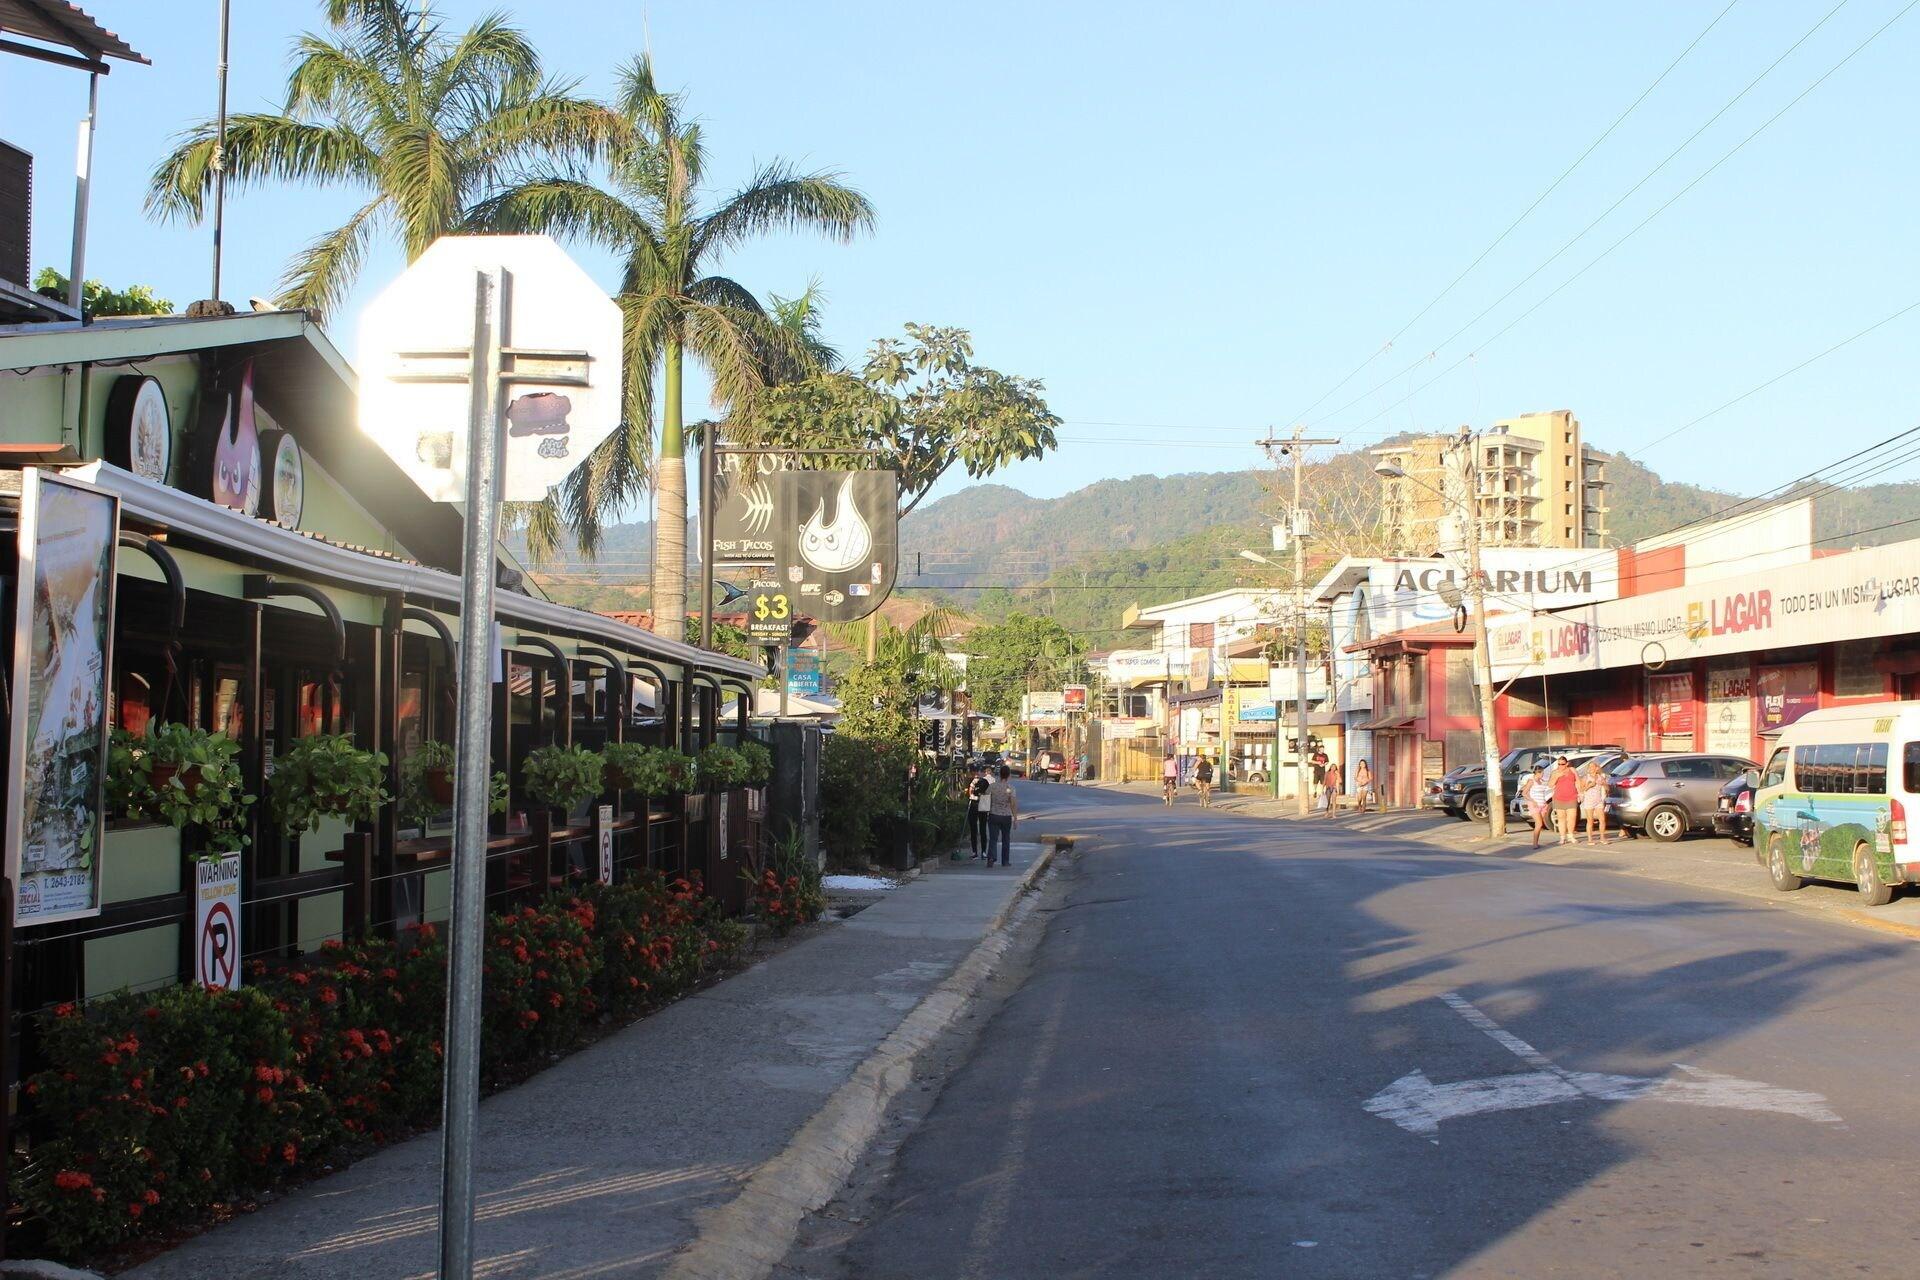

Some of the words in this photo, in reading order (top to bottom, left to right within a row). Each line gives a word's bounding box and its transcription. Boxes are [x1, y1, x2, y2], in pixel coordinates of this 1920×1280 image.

[754, 594, 789, 621] $3
[1711, 589, 1772, 636] LAGAR
[1780, 594, 1806, 616] TODO
[1809, 592, 1822, 611] EN
[1824, 589, 1839, 609] UN
[1550, 623, 1590, 658] LAGAR
[1657, 616, 1682, 635] LUGAR
[1723, 678, 1751, 698] LAGAR
[200, 861, 239, 885] WARNING
